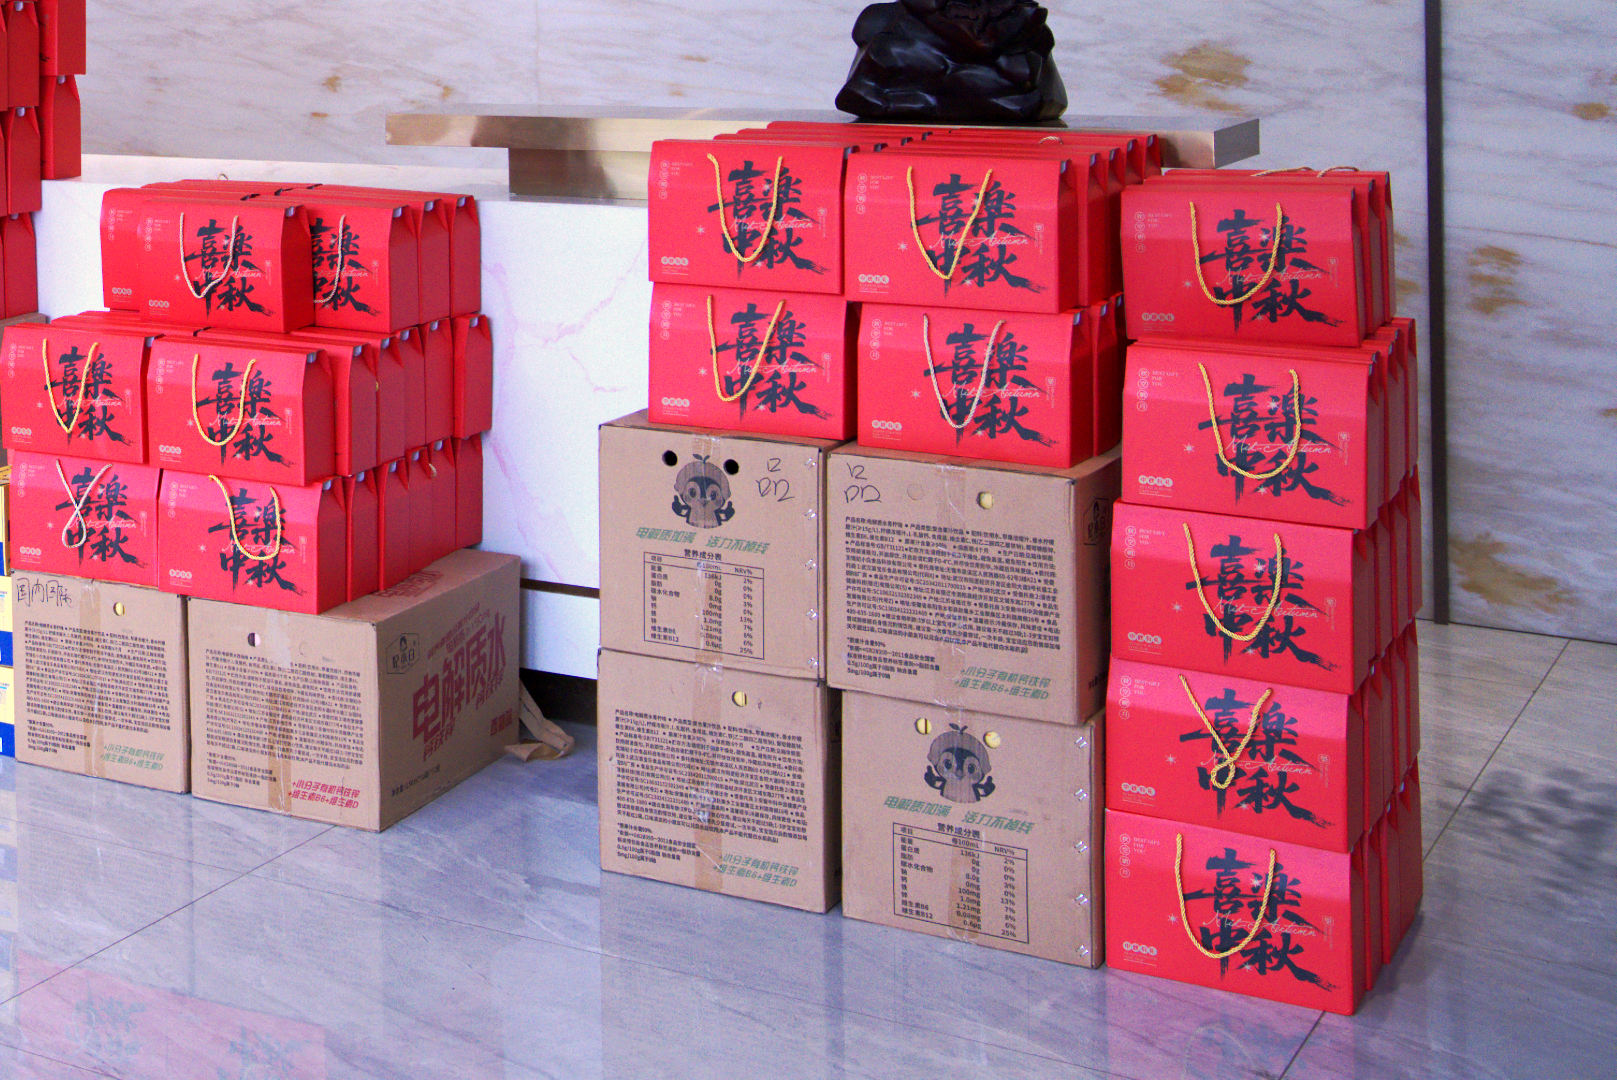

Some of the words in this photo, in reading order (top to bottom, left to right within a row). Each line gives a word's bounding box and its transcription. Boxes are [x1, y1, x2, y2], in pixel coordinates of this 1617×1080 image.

[720, 226, 832, 278] 中秋
[927, 244, 1048, 298] 中秋
[193, 275, 276, 316] 中秋
[1213, 274, 1346, 335] 中秋
[56, 402, 135, 448] 中秋
[724, 371, 833, 429] 中秋
[941, 395, 1060, 447] 中秋
[207, 421, 296, 467] 中秋
[1215, 442, 1354, 507] 中秋
[67, 525, 149, 569] 中秋
[636, 526, 697, 544] 电解质加满
[706, 535, 770, 555] 活力不掉线
[684, 549, 722, 561] 营养成分表
[220, 548, 309, 596] 中秋
[1203, 610, 1342, 671] 中秋
[413, 611, 506, 744] 电解质水
[884, 796, 952, 817] 电解质加满
[962, 810, 1035, 835] 活力不掉线
[1196, 766, 1334, 830] 中秋
[938, 823, 980, 839] 营养成分表
[1198, 927, 1341, 992] 中秋
